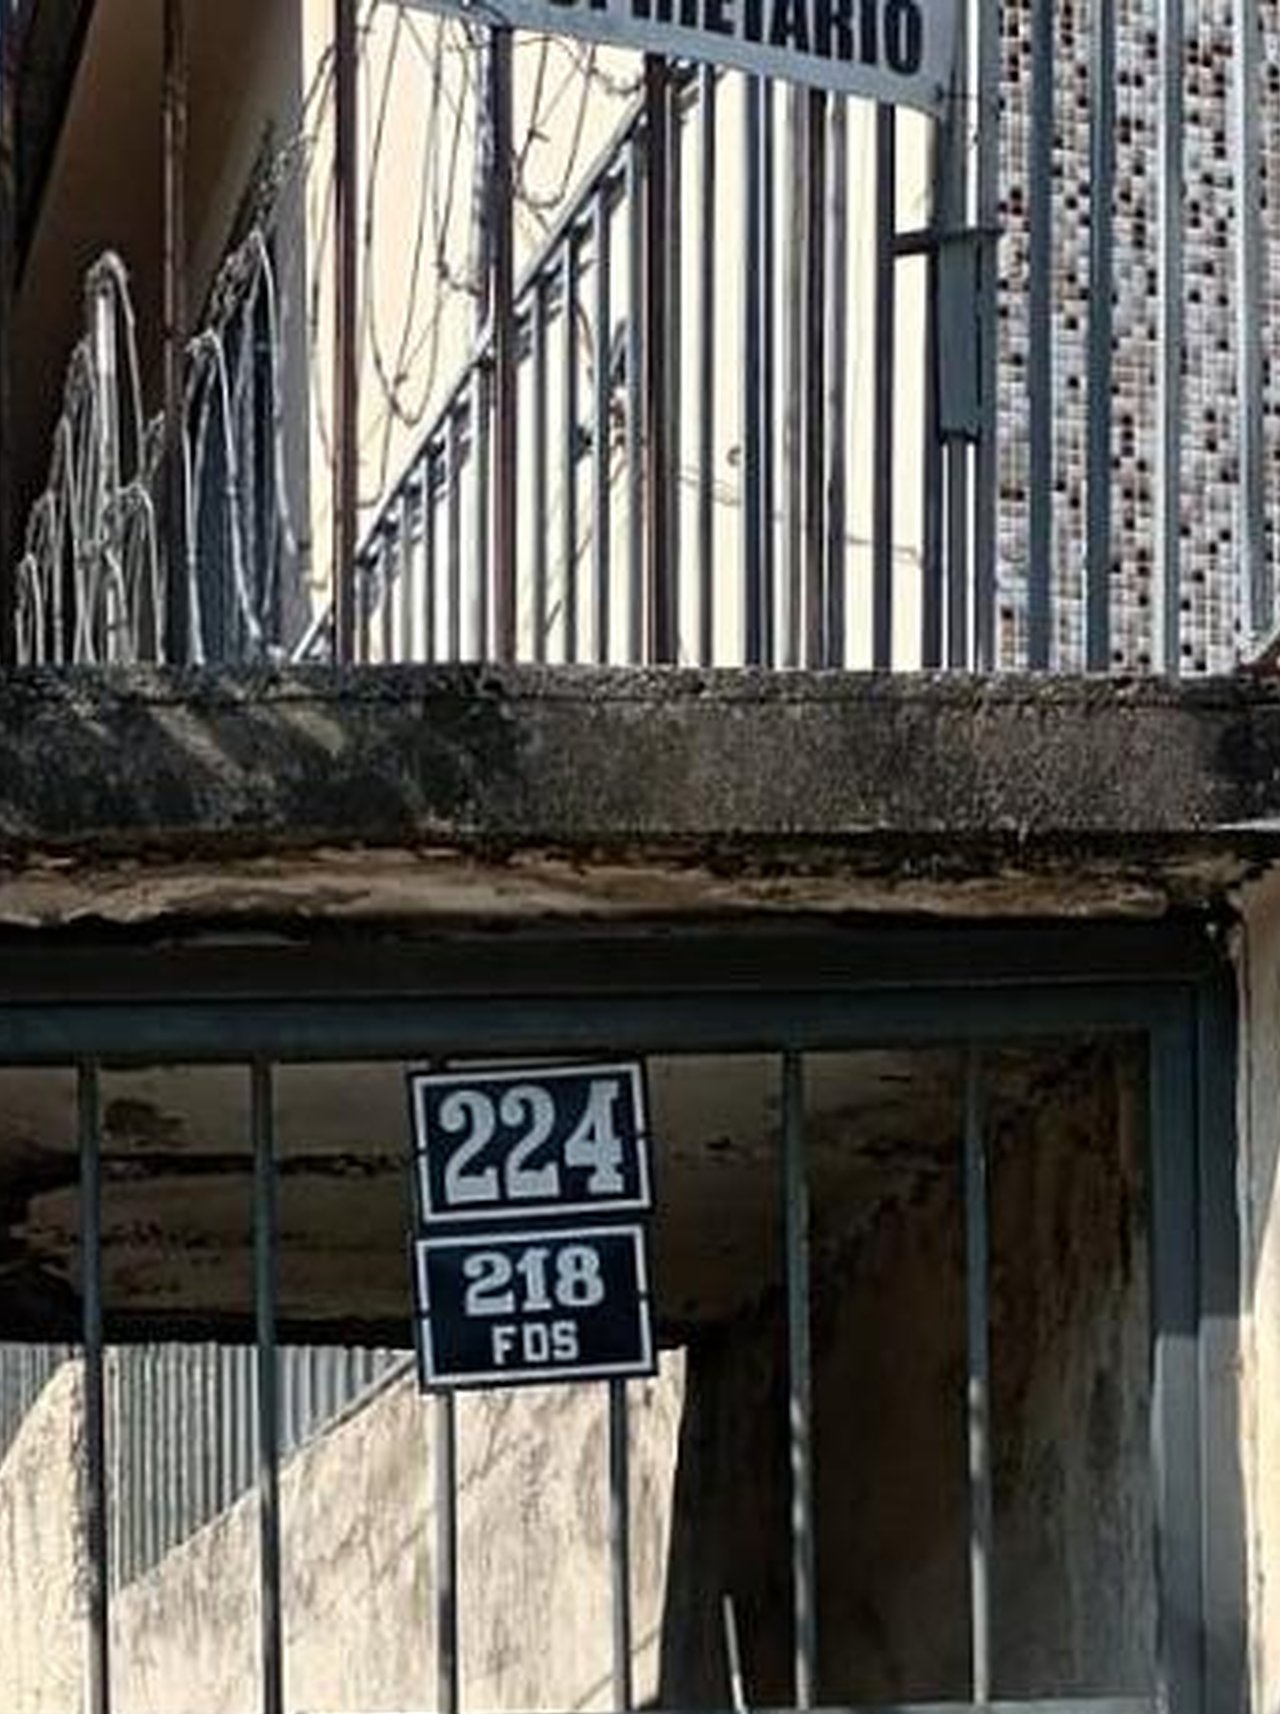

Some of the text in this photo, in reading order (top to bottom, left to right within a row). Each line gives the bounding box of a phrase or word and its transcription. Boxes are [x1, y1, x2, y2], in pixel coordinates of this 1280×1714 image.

[438, 1080, 625, 1205] 224
[462, 1244, 606, 1317] 218
[491, 1320, 580, 1366] FDS
